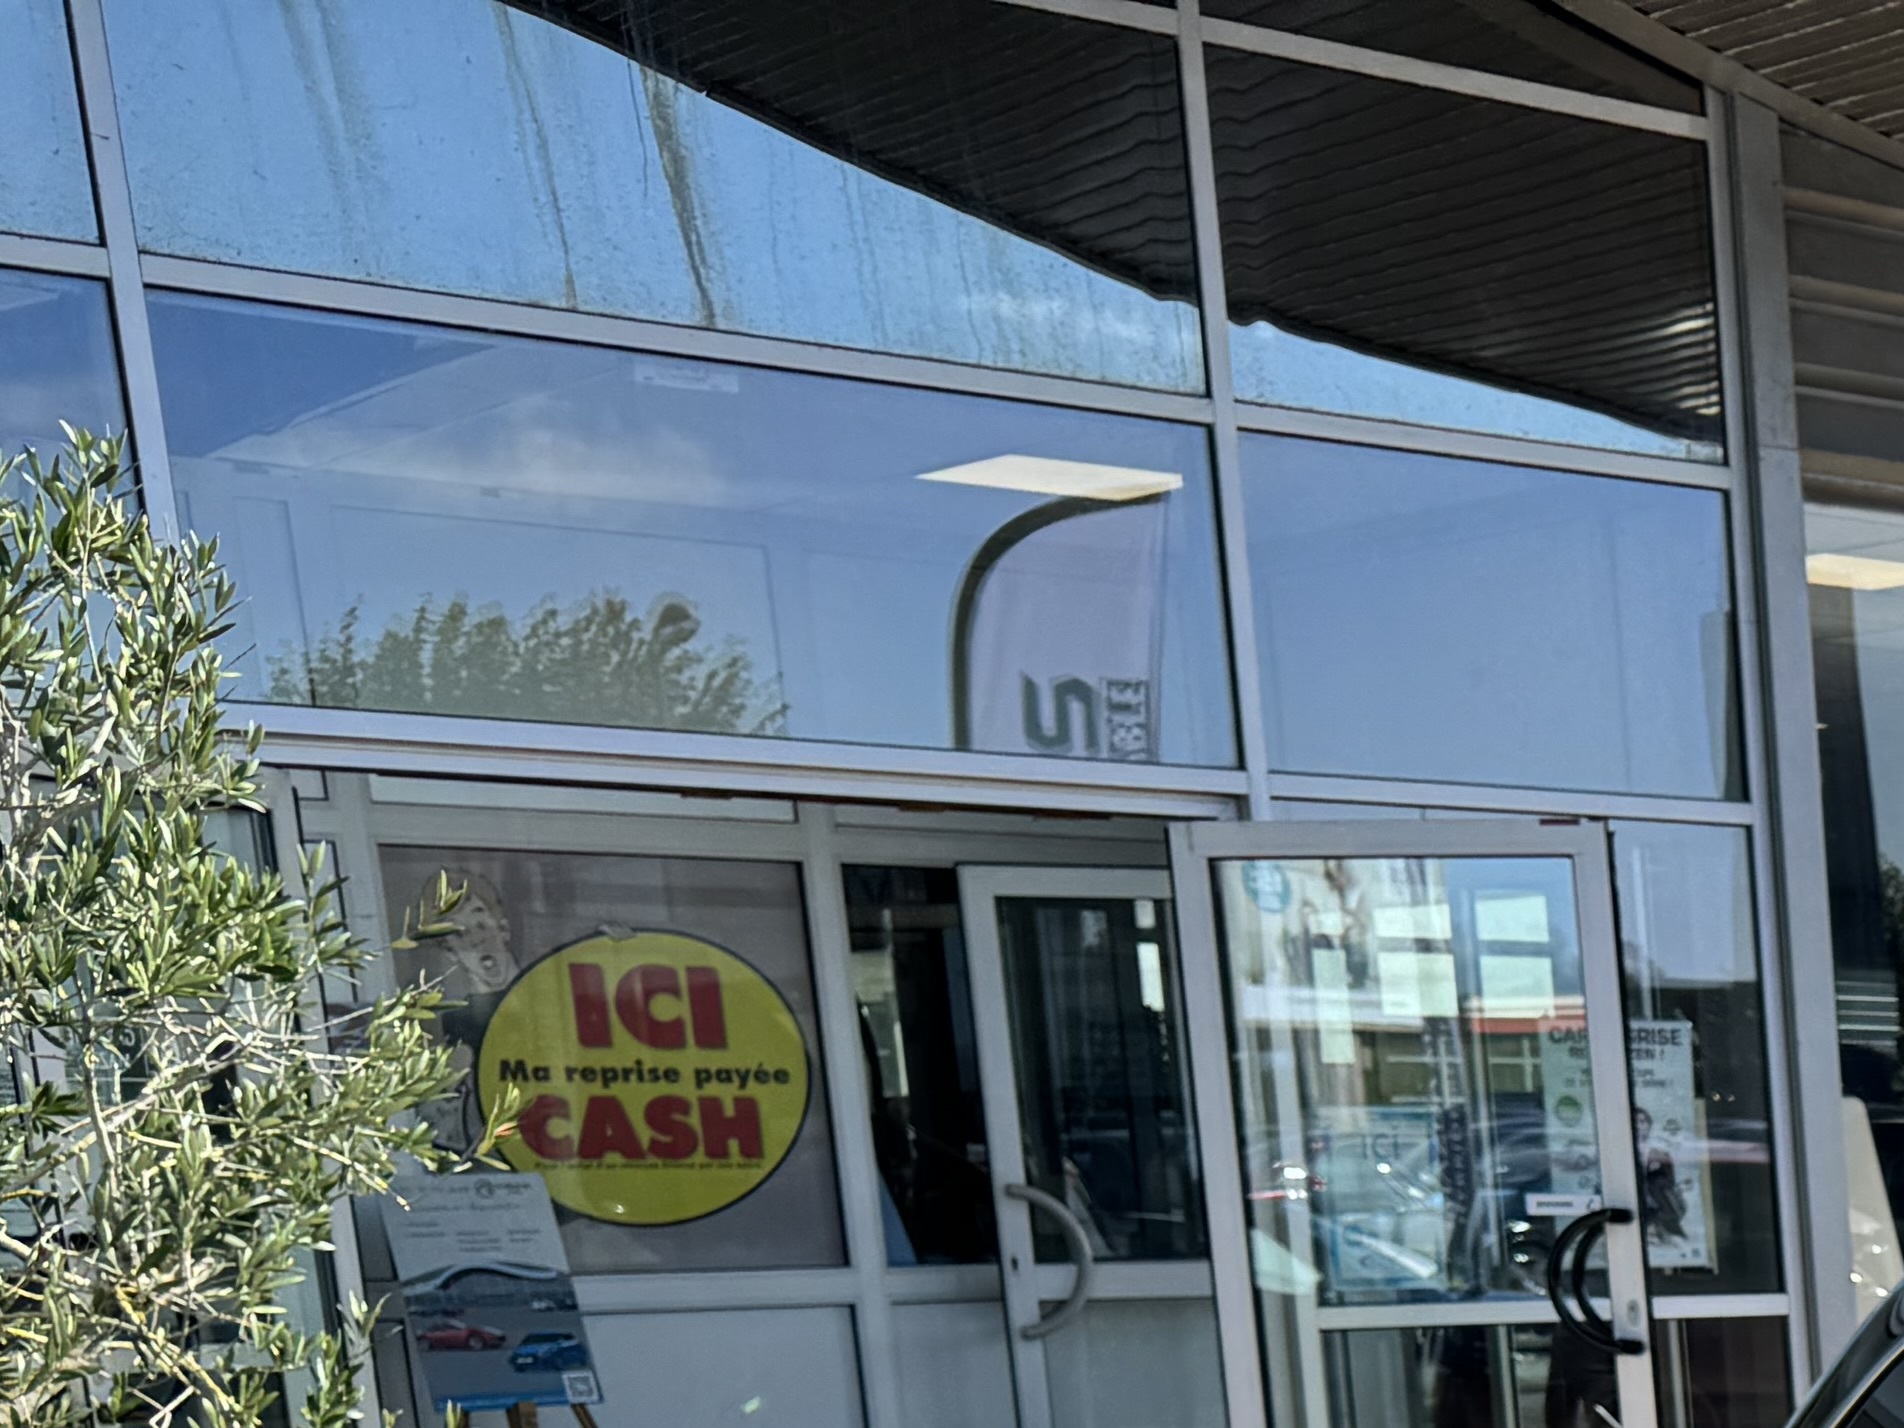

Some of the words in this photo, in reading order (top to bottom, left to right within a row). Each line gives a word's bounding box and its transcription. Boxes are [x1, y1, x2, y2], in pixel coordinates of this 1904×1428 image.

[565, 961, 730, 1050] ICI
[498, 1057, 552, 1085] Ma
[565, 1058, 681, 1089] reprise
[693, 1058, 792, 1092] payée
[517, 1092, 767, 1161] CASH
